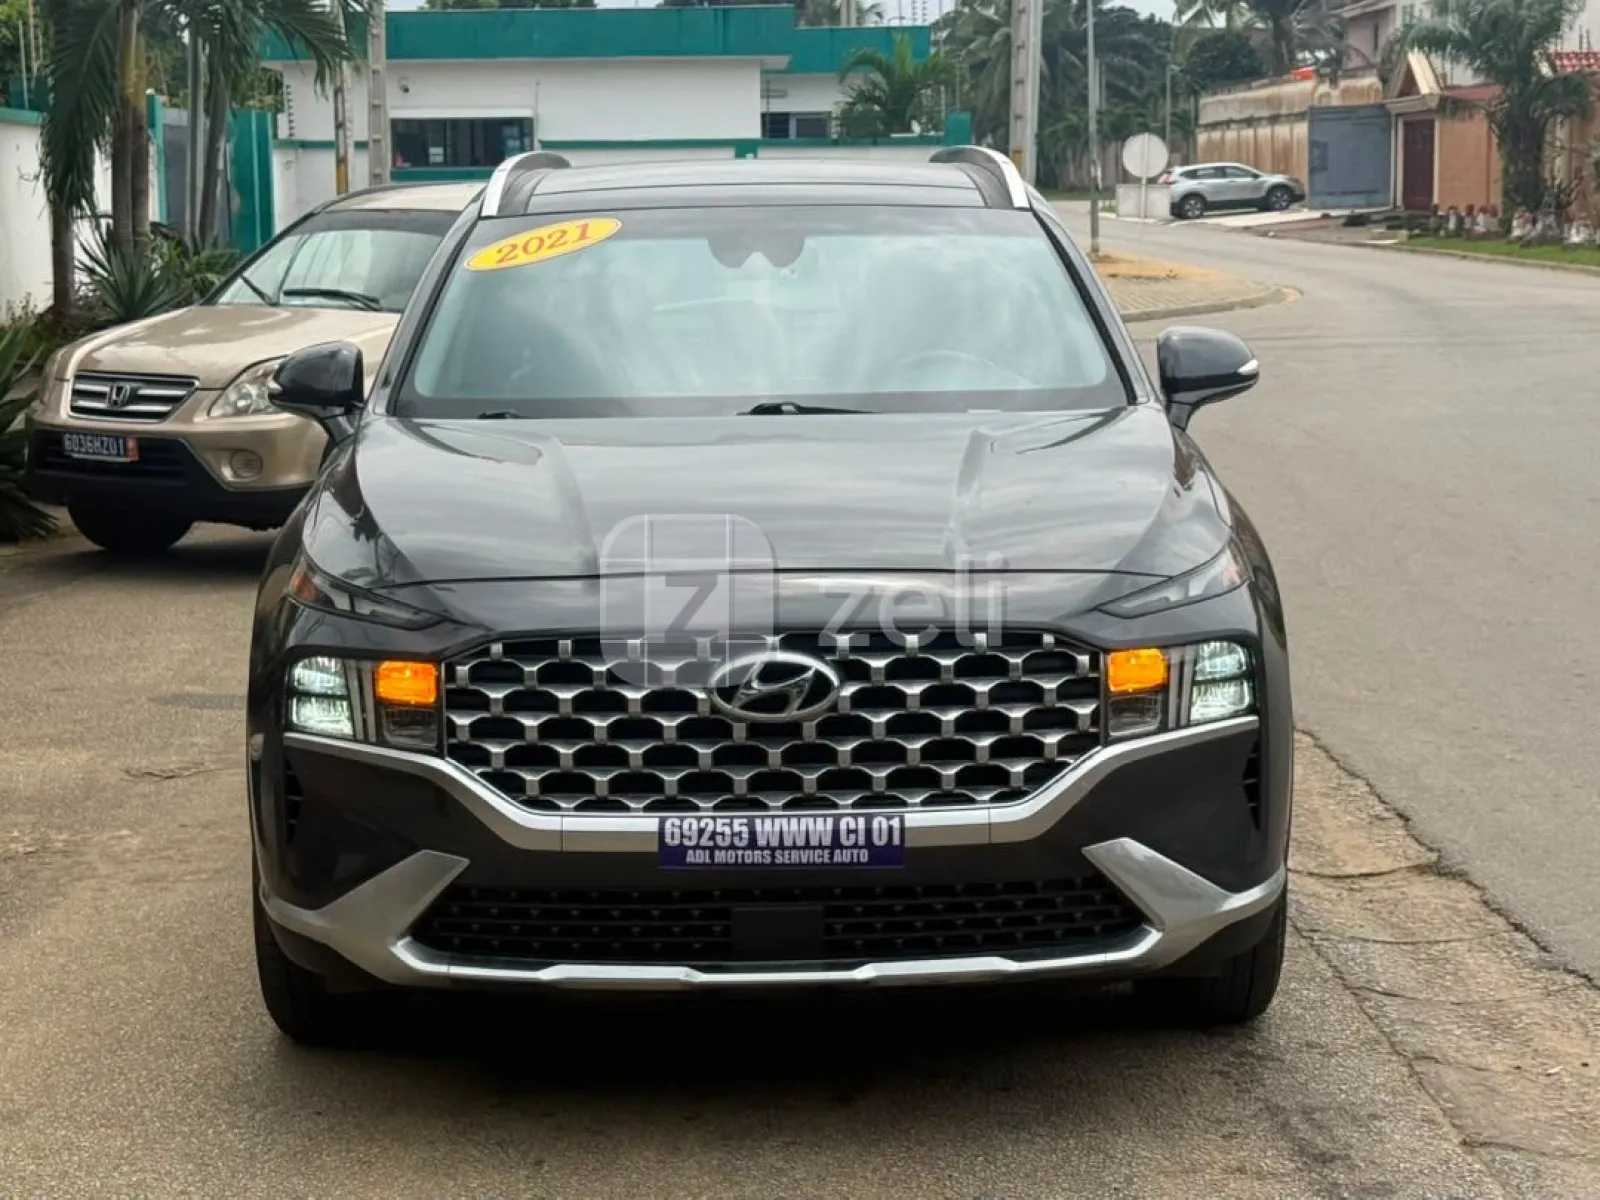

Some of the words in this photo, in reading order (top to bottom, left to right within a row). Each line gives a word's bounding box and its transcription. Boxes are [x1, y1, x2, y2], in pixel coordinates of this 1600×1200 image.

[495, 222, 592, 264] 2021
[664, 817, 749, 847] 69255
[755, 816, 834, 847] WWW
[840, 815, 866, 847] CI
[872, 815, 901, 847] 01
[714, 849, 771, 864] MOTORS
[774, 849, 831, 864] SERVICE
[833, 848, 869, 863] AUTO
